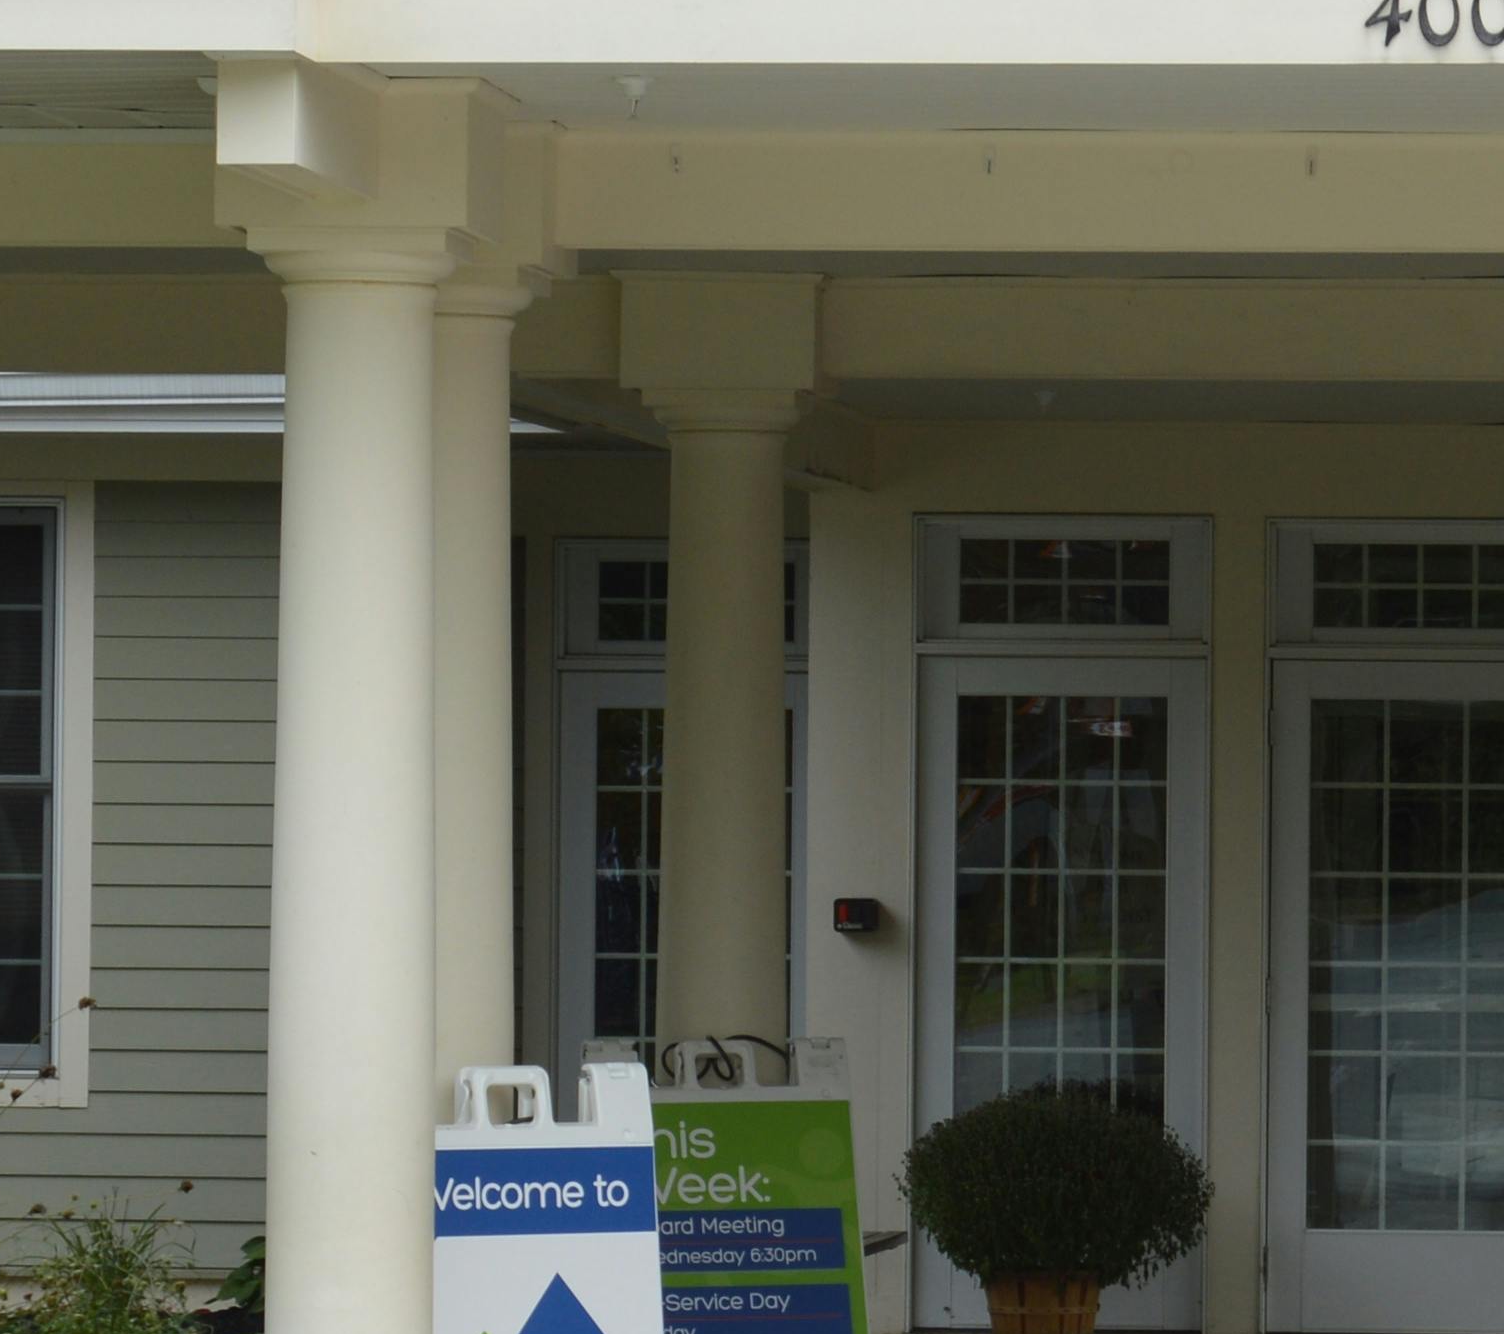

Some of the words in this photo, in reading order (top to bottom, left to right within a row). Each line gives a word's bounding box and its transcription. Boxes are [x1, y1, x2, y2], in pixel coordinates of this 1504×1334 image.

[593, 1173, 630, 1207] to
[657, 1217, 694, 1235] ard
[701, 1216, 785, 1237] Meeting
[659, 1248, 745, 1266] ednesday
[750, 1247, 817, 1268] 6:30pm
[749, 1292, 791, 1313] Day
